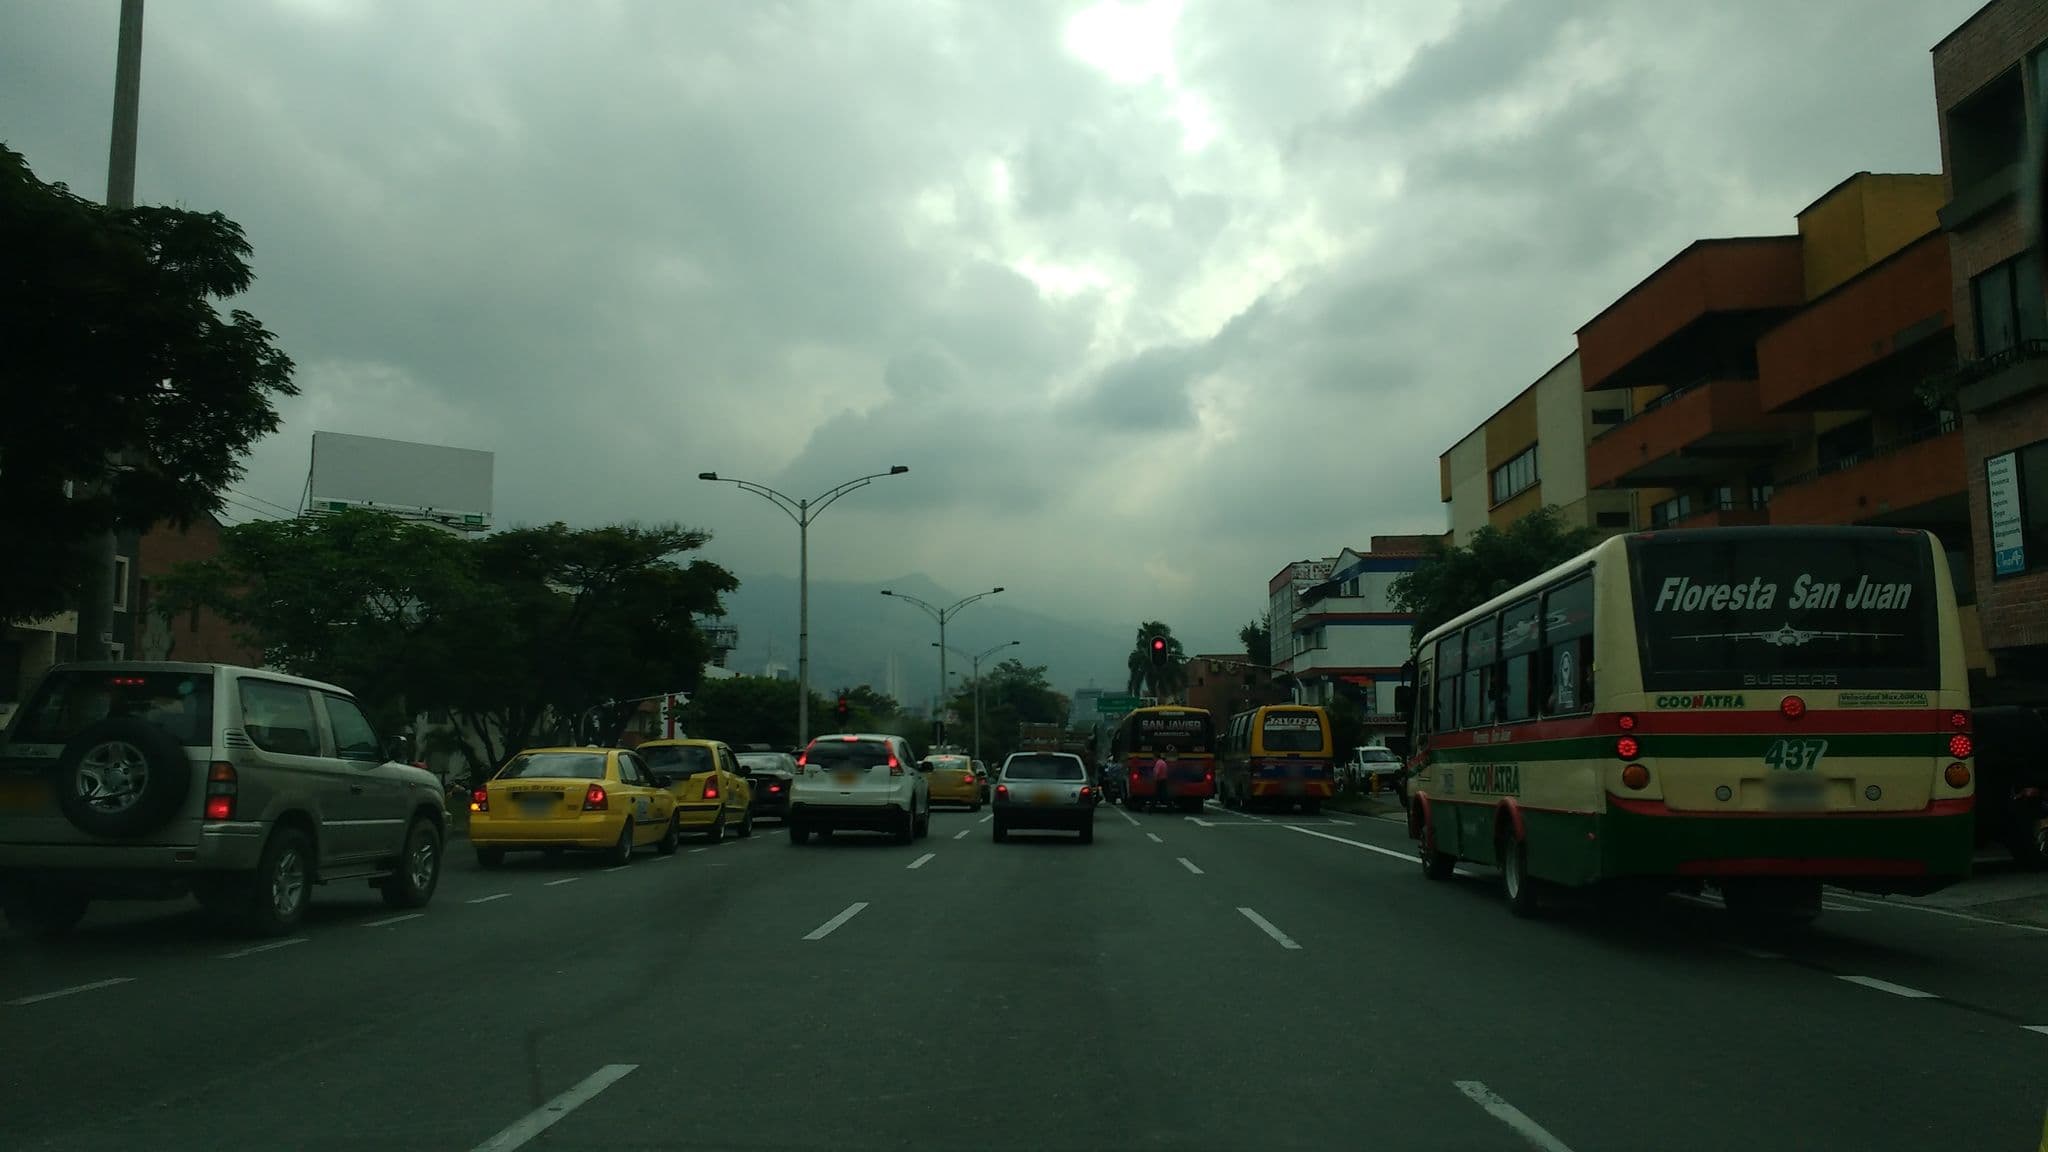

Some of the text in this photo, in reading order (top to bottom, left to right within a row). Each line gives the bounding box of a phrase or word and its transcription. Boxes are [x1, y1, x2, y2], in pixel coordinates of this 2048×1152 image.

[1654, 573, 1913, 612] Floresta San Juan
[1743, 673, 1839, 686] BUSSCAR
[1657, 695, 1744, 708] COONATRA
[1142, 720, 1201, 729] SAN JAVIER
[1765, 737, 1829, 770] 437
[1468, 763, 1519, 794] COONATRA
